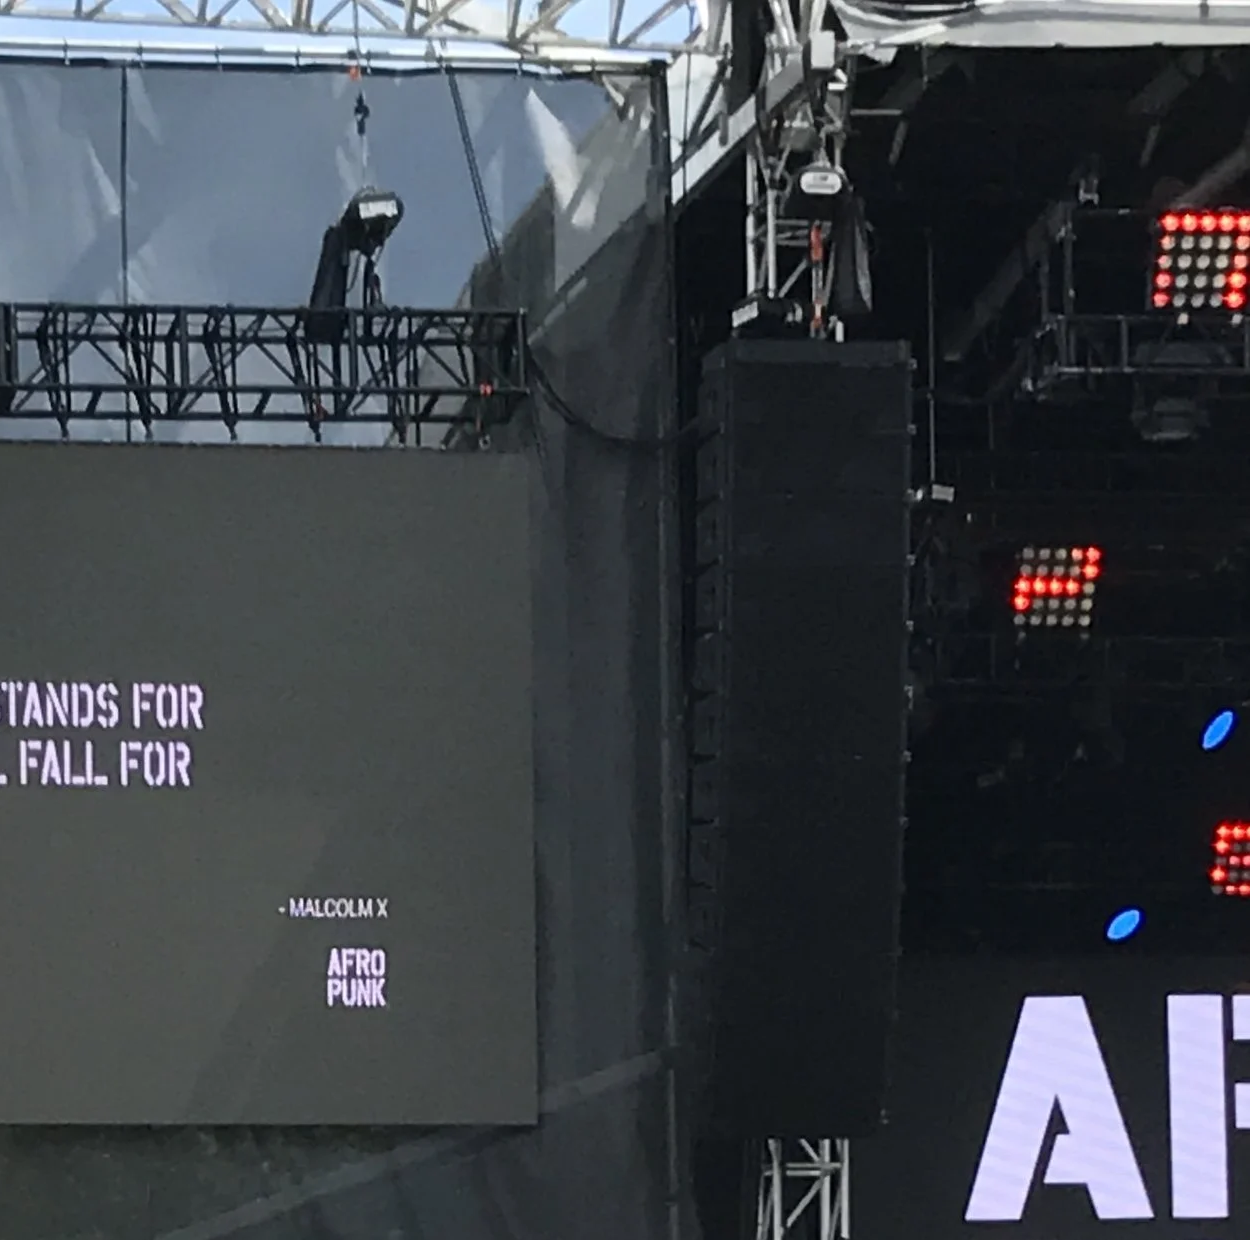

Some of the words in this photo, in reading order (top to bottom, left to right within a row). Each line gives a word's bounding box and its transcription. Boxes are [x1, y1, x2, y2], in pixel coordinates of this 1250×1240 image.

[132, 682, 204, 730] FOR
[19, 739, 109, 786] FALL
[120, 740, 191, 787] FOR
[289, 897, 374, 919] MALCOLM
[376, 897, 389, 919] X
[327, 947, 386, 977] AFRO
[326, 977, 387, 1008] PUNK
